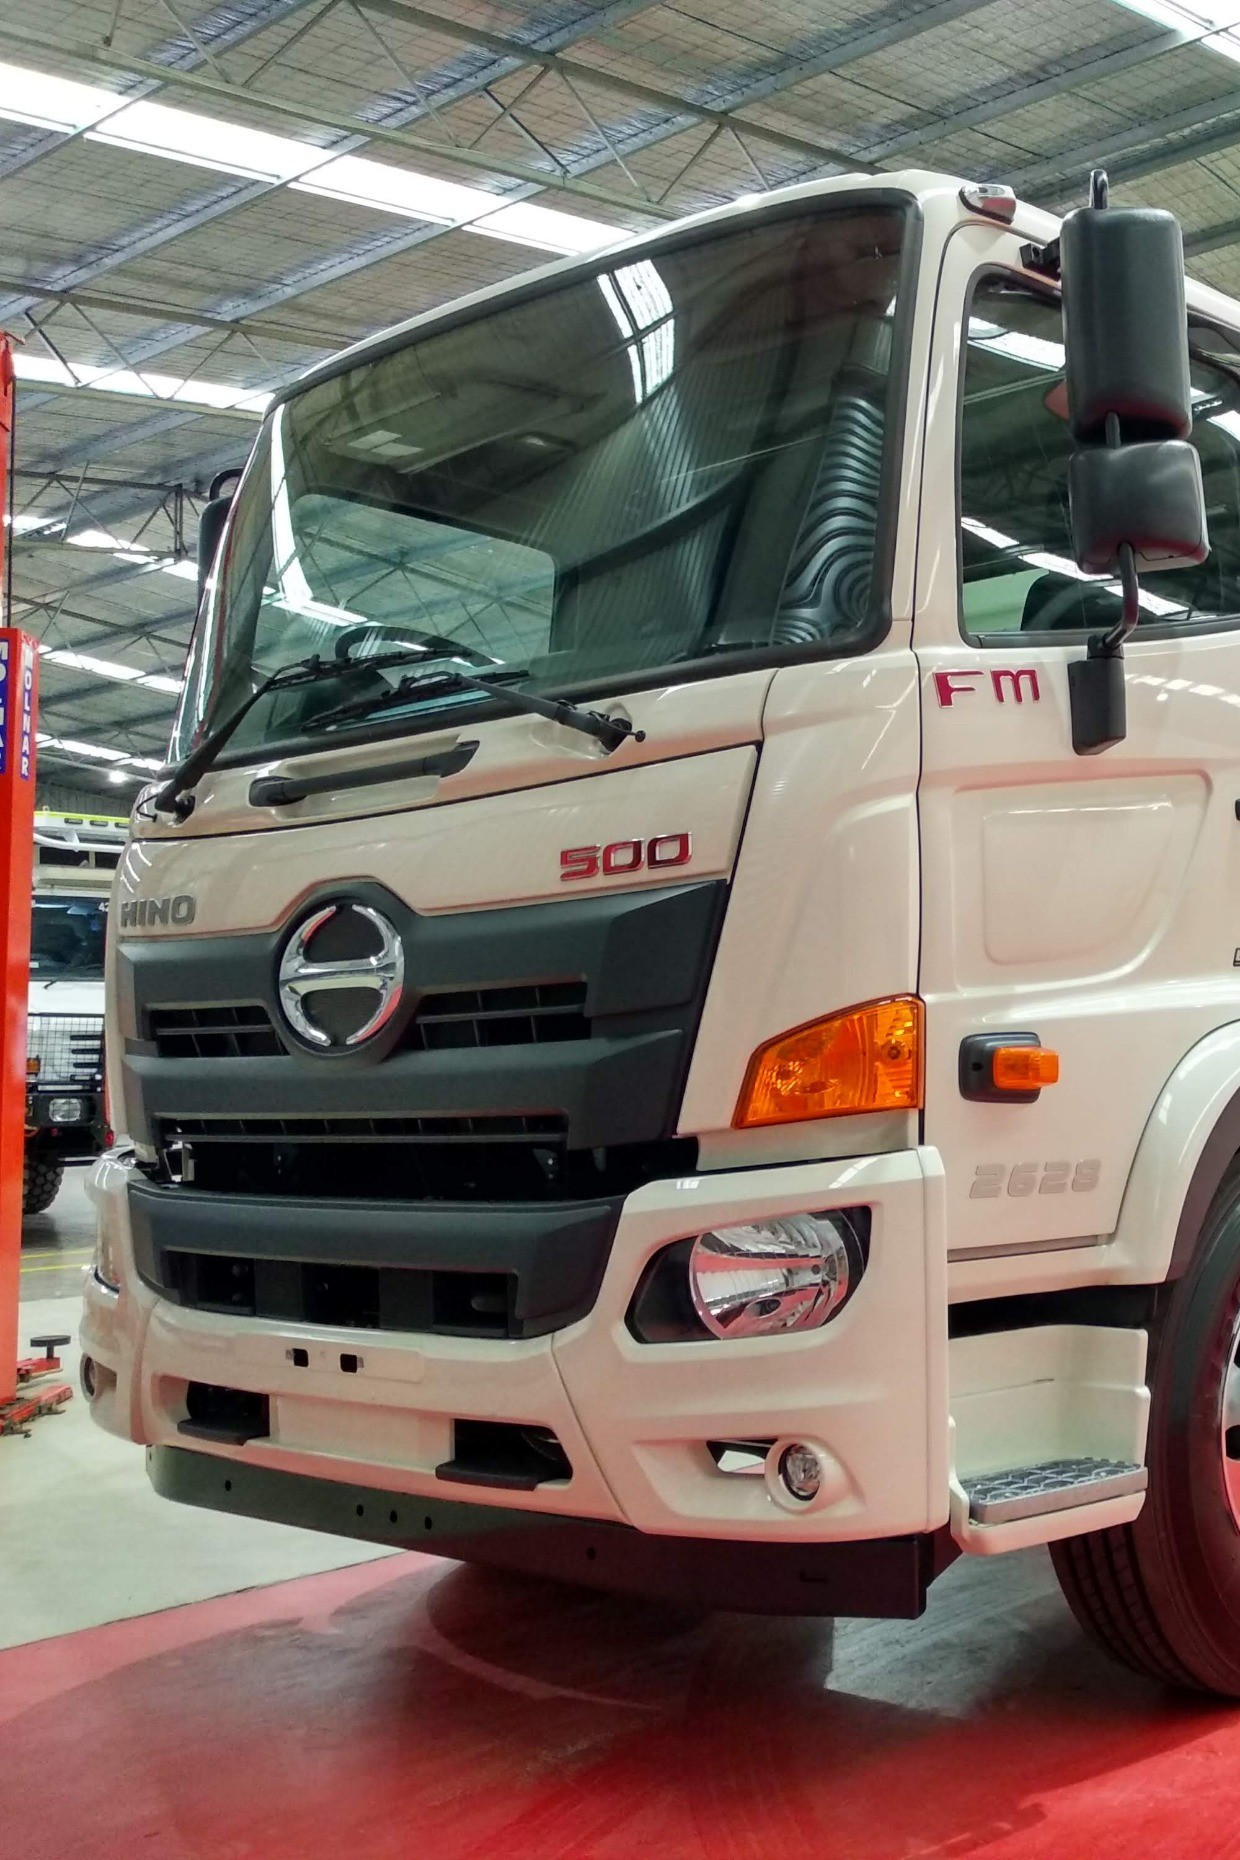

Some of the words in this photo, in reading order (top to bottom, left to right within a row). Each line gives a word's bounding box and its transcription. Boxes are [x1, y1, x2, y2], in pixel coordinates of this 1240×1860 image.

[933, 669, 1041, 708] FM
[560, 831, 692, 881] 500
[120, 895, 196, 928] HINO
[969, 1158, 1102, 1199] 2628
